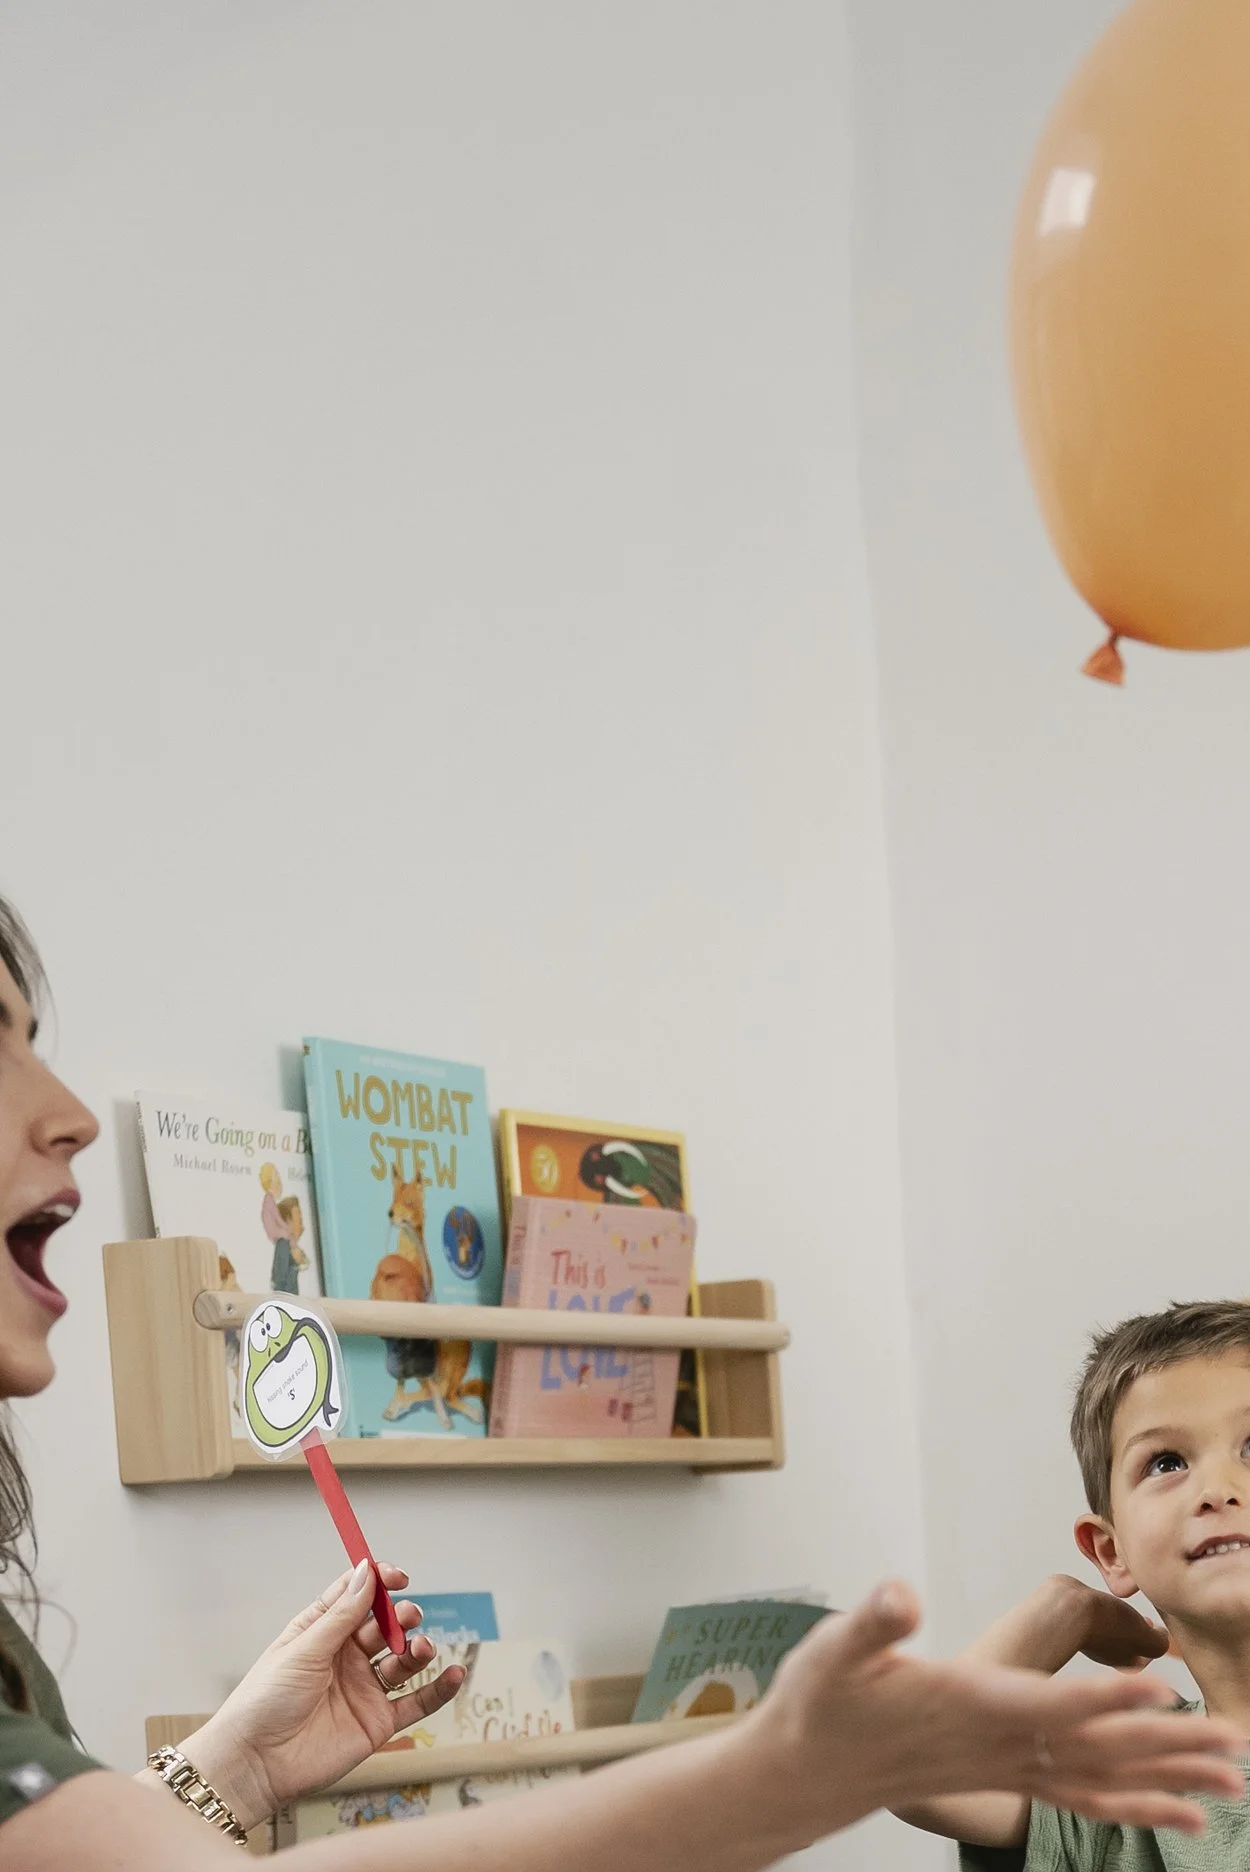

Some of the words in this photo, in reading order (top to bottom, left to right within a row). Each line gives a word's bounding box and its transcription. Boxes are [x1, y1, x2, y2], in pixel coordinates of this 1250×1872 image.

[335, 1069, 473, 1136] WOMBAT
[156, 1109, 199, 1143] We're
[205, 1116, 255, 1157] Going
[258, 1130, 277, 1150] on
[282, 1133, 291, 1153] a
[369, 1131, 457, 1189] STEW
[551, 1250, 589, 1290] This
[594, 1258, 607, 1290] is
[695, 1613, 790, 1645] SUPER
